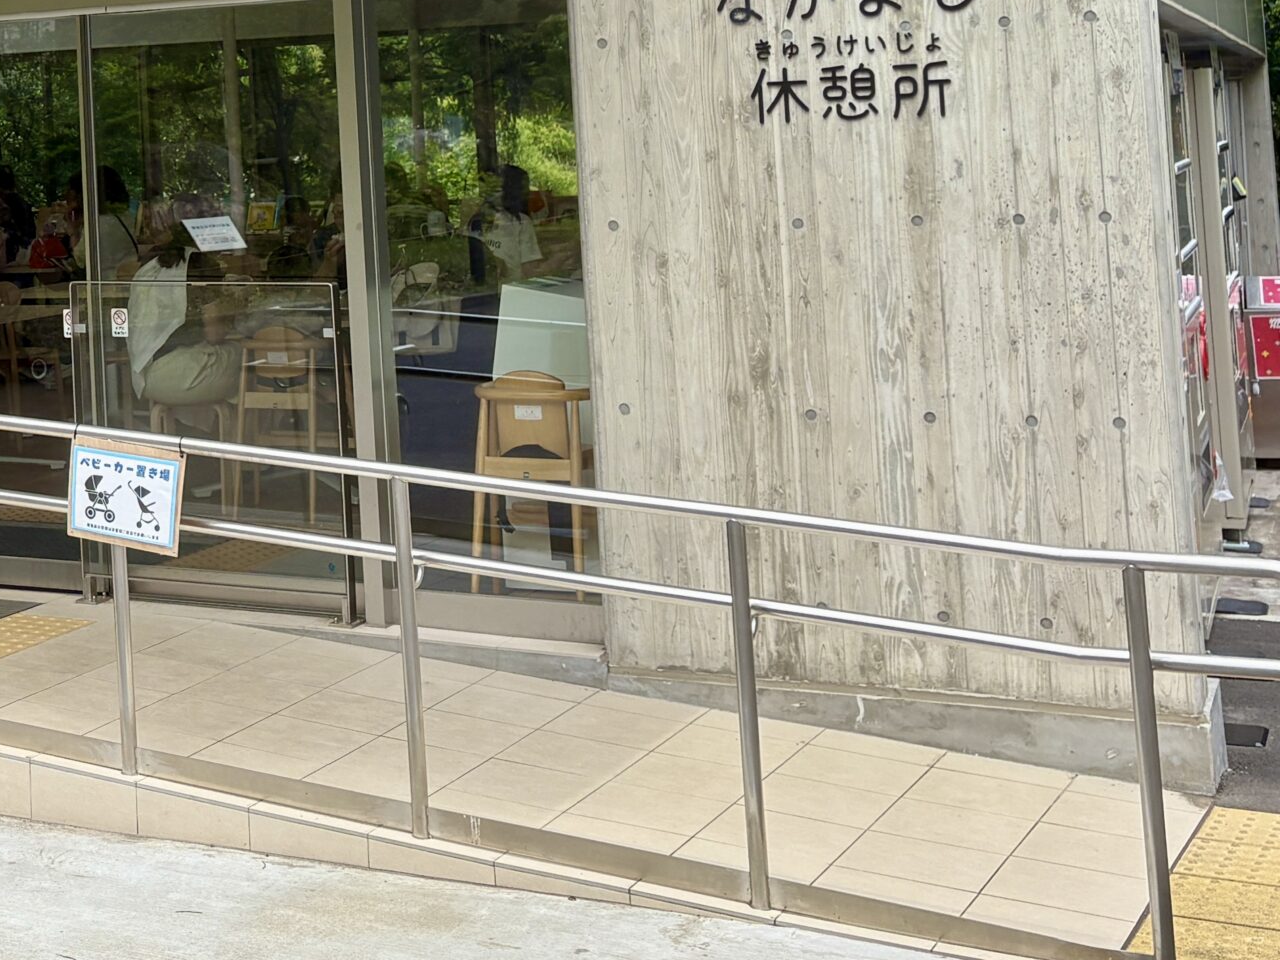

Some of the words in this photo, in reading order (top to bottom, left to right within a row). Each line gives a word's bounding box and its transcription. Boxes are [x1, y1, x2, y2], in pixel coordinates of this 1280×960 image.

[755, 33, 942, 60] きゅうけいじょ
[750, 60, 952, 124] 休憩所
[80, 457, 170, 482] ベビーカー置き場
